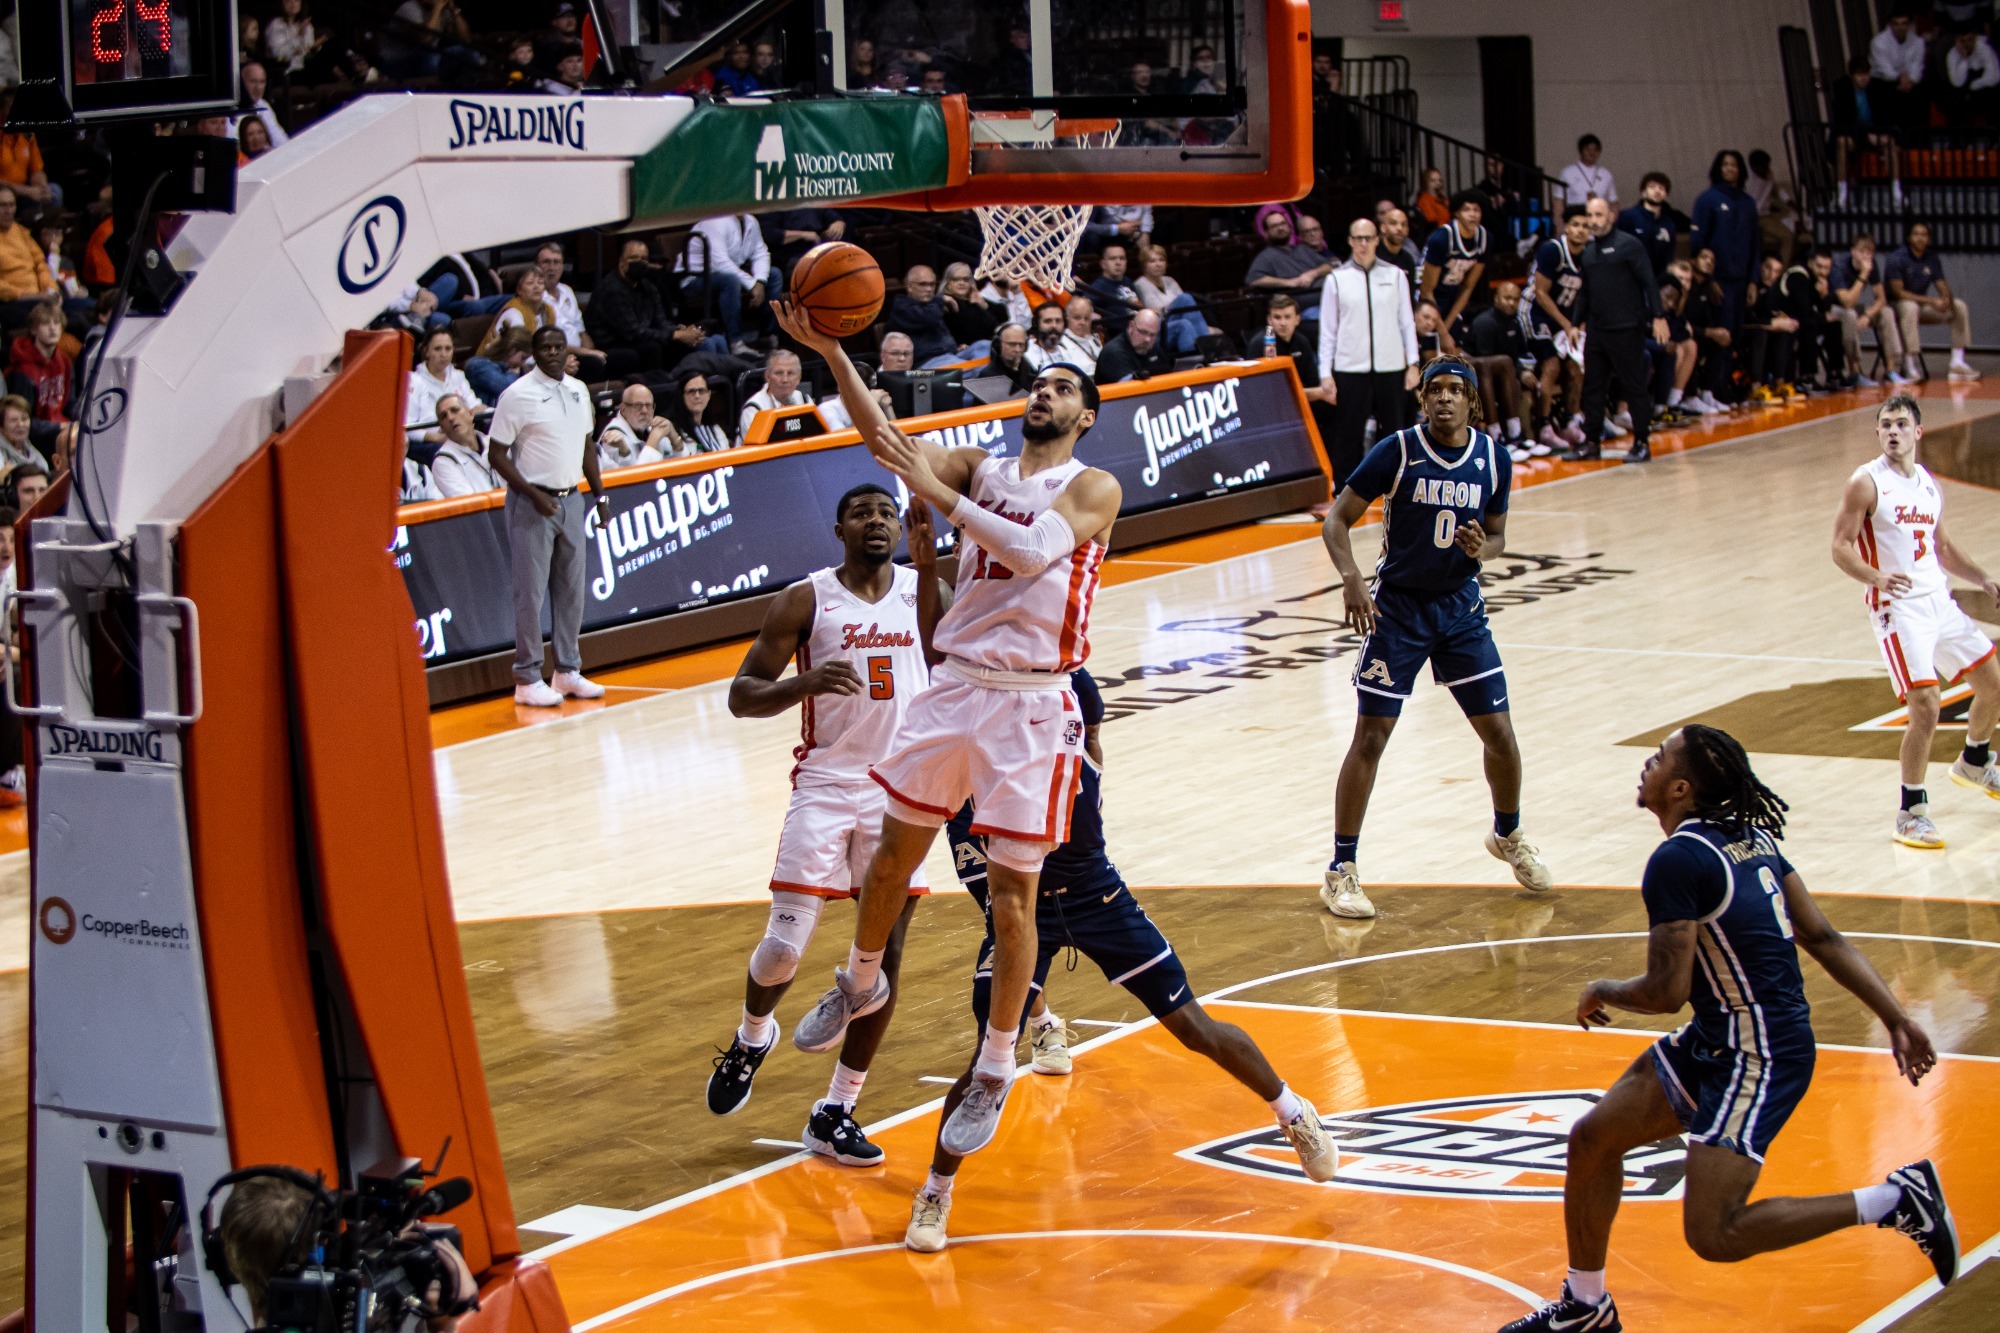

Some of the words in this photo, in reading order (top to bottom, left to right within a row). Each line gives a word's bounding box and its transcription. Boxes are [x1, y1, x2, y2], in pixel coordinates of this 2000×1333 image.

[450, 99, 585, 151] SPALDING
[794, 152, 837, 175] WOOD
[838, 151, 895, 173] COUNTY
[795, 176, 862, 198] HOSPITAL
[1133, 377, 1241, 487] Juniper
[1412, 478, 1482, 509] AKRON
[1433, 509, 1457, 549] 0
[1894, 505, 1935, 525] Falcons
[584, 465, 735, 601] Juniper
[617, 547, 664, 578] BREWING
[664, 539, 679, 555] CO
[710, 513, 734, 532] OHIO
[1913, 530, 1927, 562] 3
[841, 622, 915, 650] Falcons
[867, 655, 895, 700] 5
[1360, 658, 1396, 687] A
[49, 723, 164, 762] SPALDING
[955, 841, 987, 871] A
[1758, 866, 1794, 939] 2
[82, 913, 189, 939] CopperBeech
[1362, 1162, 1494, 1181] 1946
